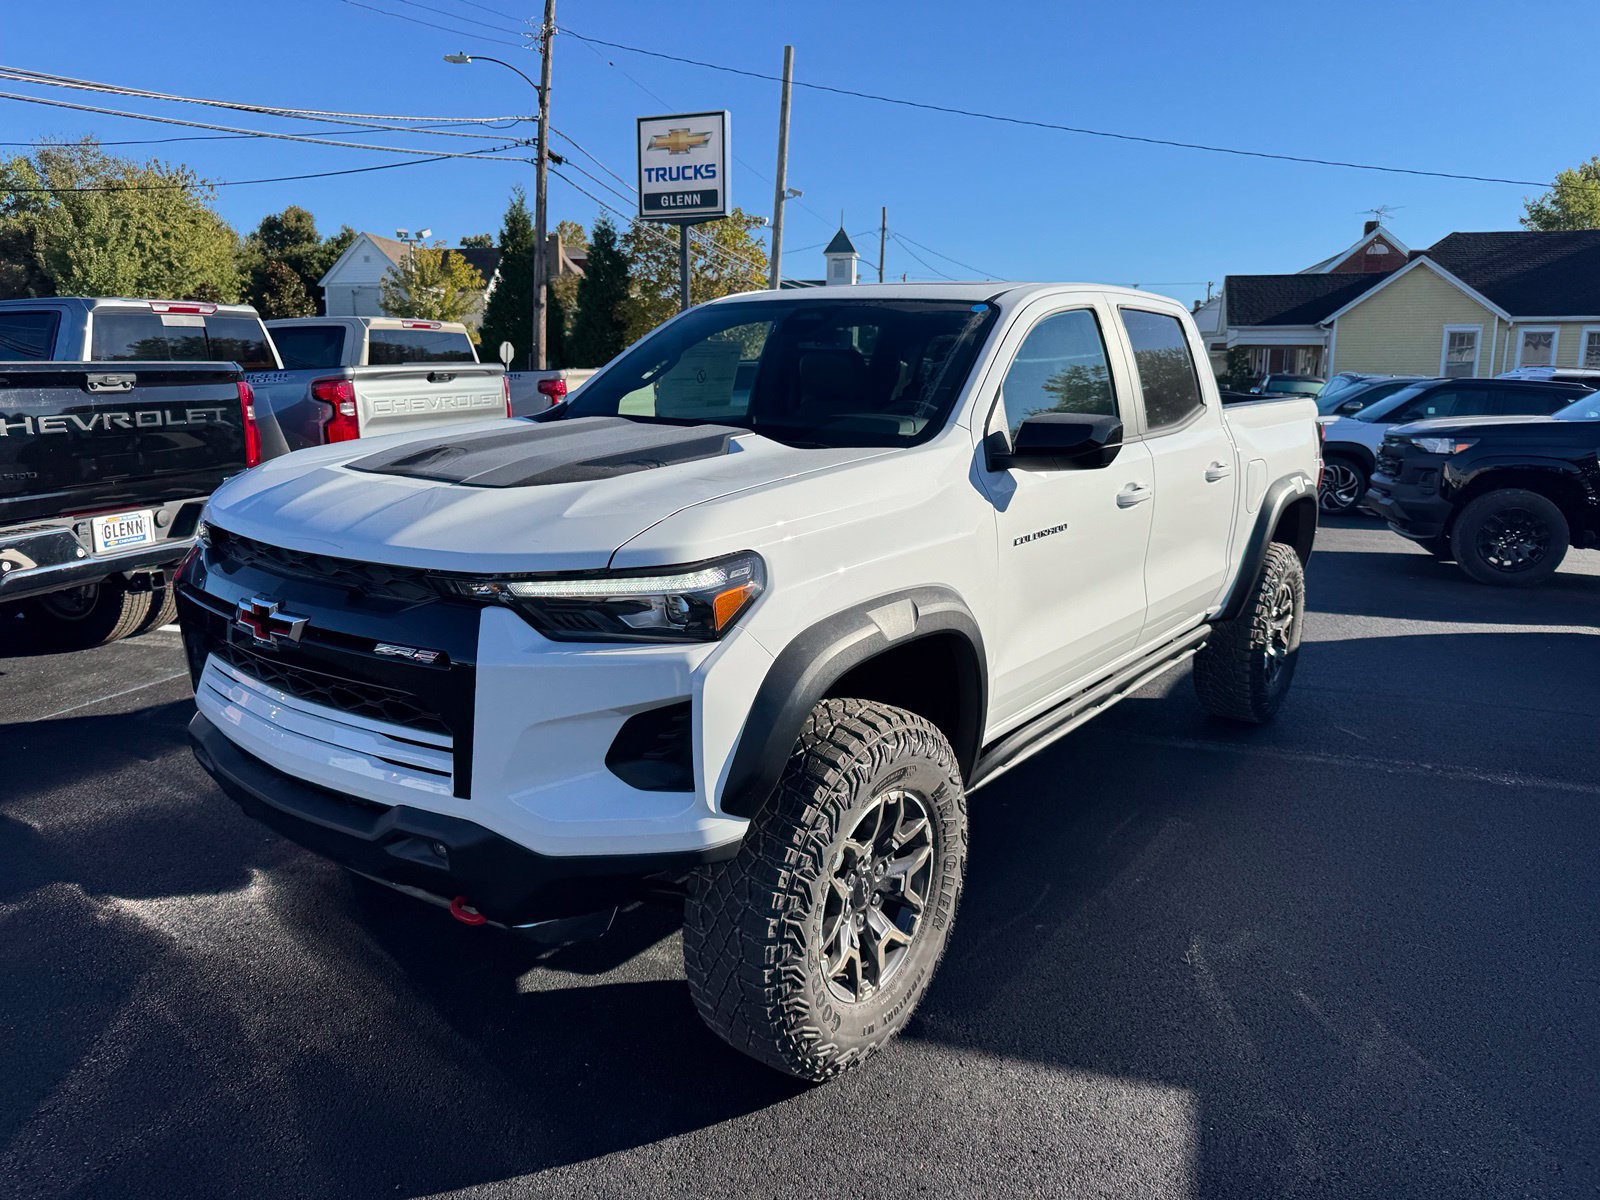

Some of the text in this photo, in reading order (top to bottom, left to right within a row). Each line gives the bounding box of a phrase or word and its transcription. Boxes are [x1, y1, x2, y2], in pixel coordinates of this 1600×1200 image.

[644, 163, 717, 183] TRUCKS
[660, 193, 701, 206] GLENN
[373, 393, 501, 414] CHEVROLET
[104, 519, 143, 539] GLENN
[1013, 523, 1068, 547] COLORADO
[930, 780, 958, 931] WRANGLER
